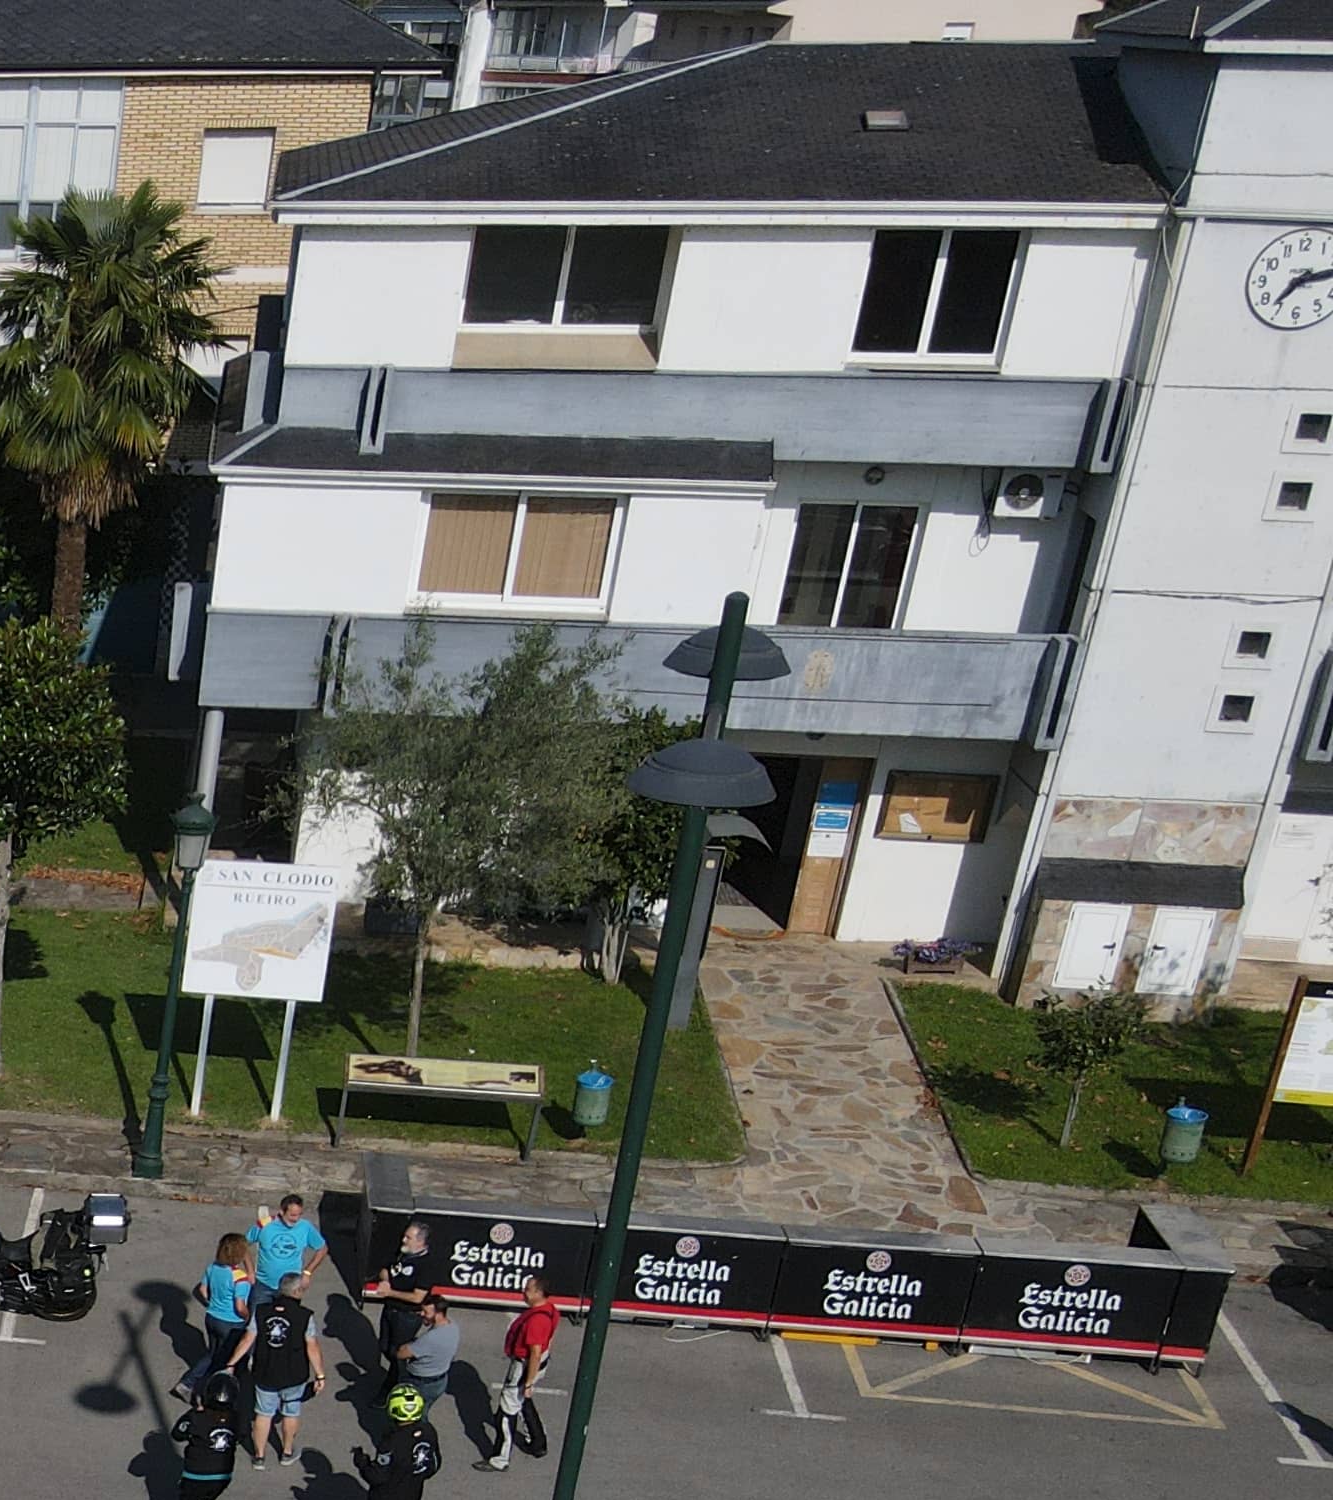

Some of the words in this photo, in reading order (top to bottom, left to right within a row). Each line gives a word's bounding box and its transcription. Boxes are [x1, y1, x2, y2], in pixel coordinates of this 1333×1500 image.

[1283, 244, 1292, 257] 11
[1299, 238, 1312, 251] 12
[1322, 242, 1326, 255] 1
[1266, 258, 1279, 271] 10
[1258, 275, 1267, 288] 9
[1260, 292, 1270, 305] 8
[1313, 298, 1322, 312] 5
[1291, 306, 1300, 319] 6
[218, 869, 252, 881] SAN
[263, 871, 333, 886] CLODIO
[233, 892, 296, 905] RUEIRO
[450, 1240, 544, 1269] Estrella
[634, 1254, 731, 1282] Estrella
[823, 1269, 922, 1297] Estrella
[635, 1277, 721, 1305] Galicia
[1019, 1283, 1122, 1311] Estrella
[823, 1293, 912, 1319] Galicia
[1018, 1307, 1110, 1335] Galicia
